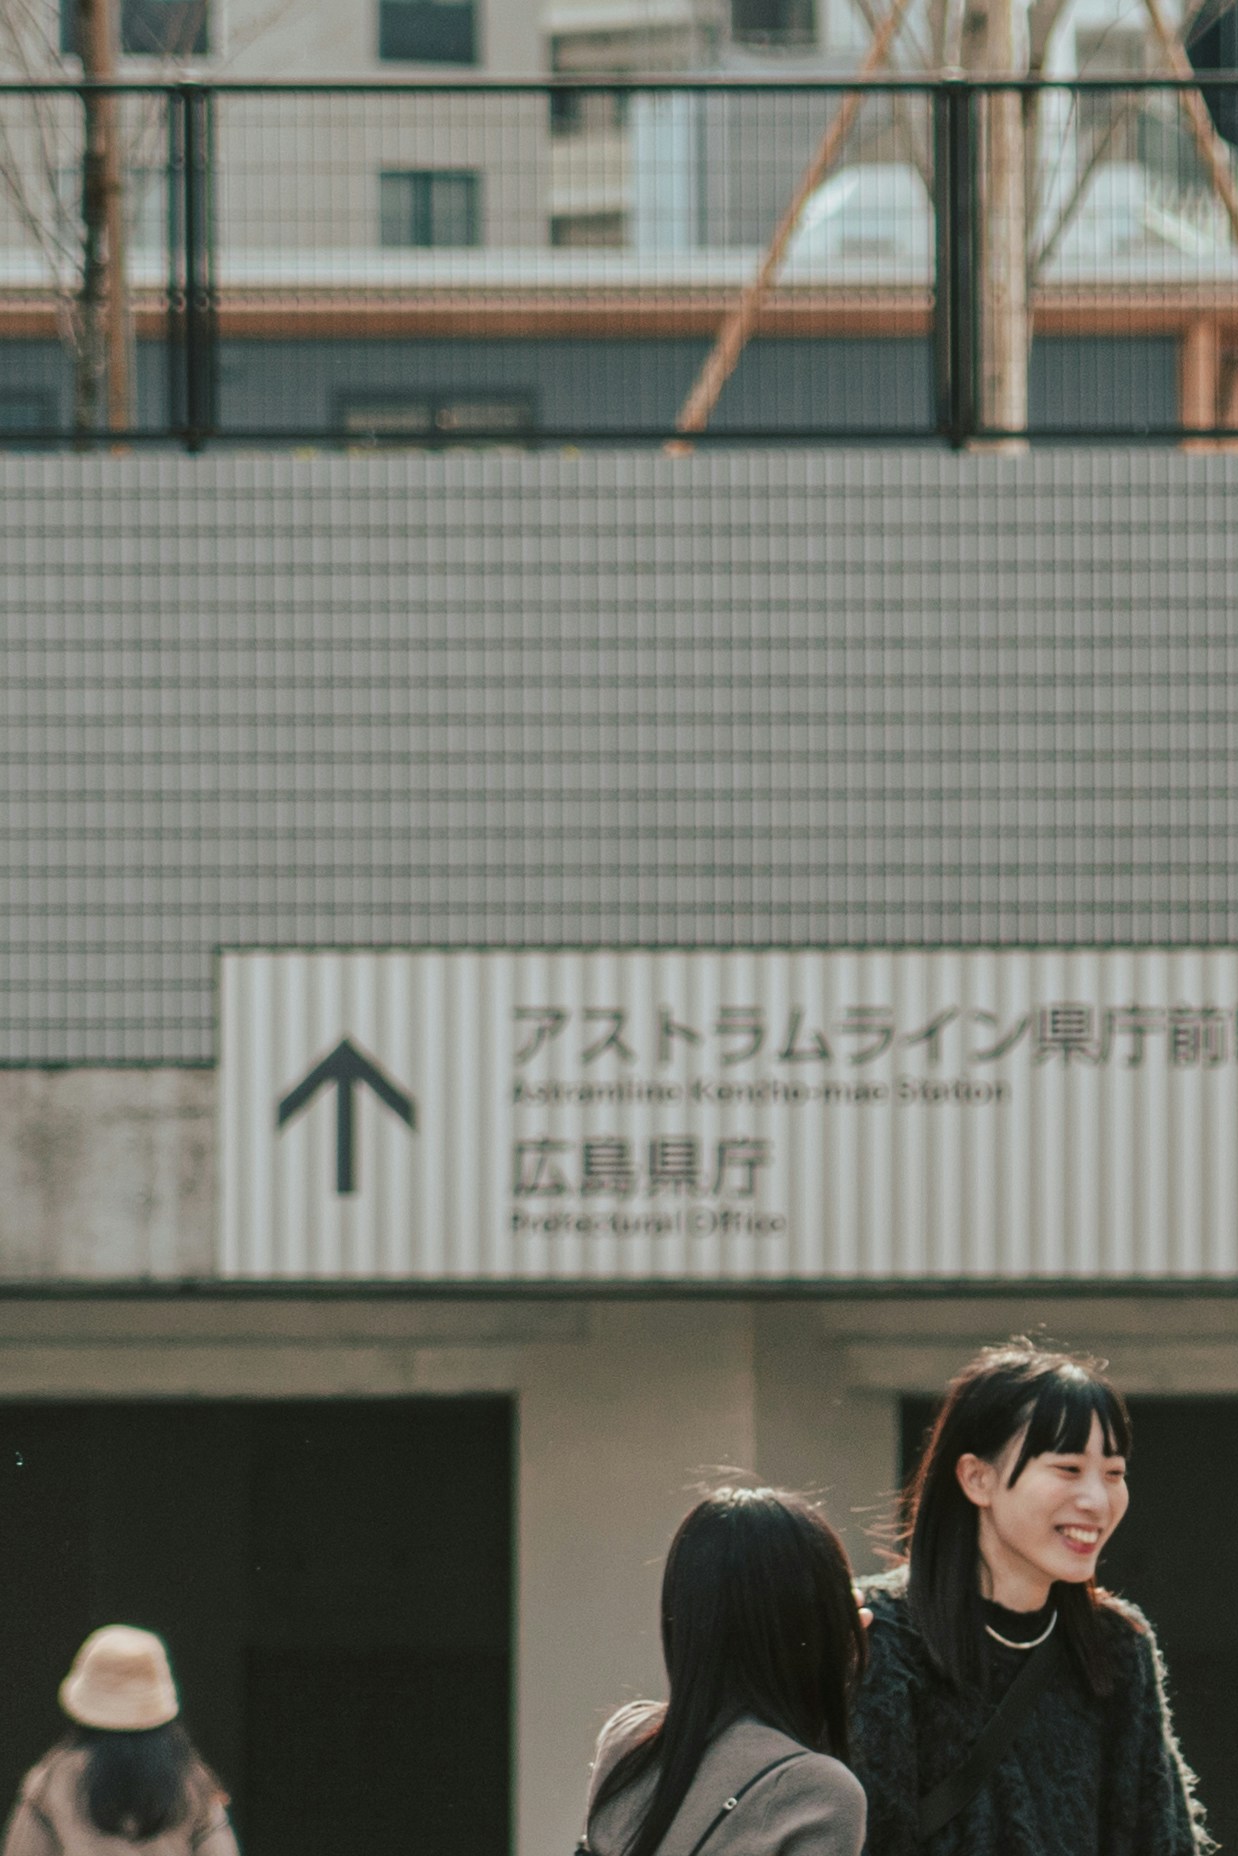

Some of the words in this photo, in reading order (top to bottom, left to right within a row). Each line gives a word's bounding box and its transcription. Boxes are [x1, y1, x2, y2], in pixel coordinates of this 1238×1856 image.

[900, 1080, 1013, 1104] Station
[513, 1138, 774, 1197] 広島県庁
[686, 1206, 788, 1235] Office
